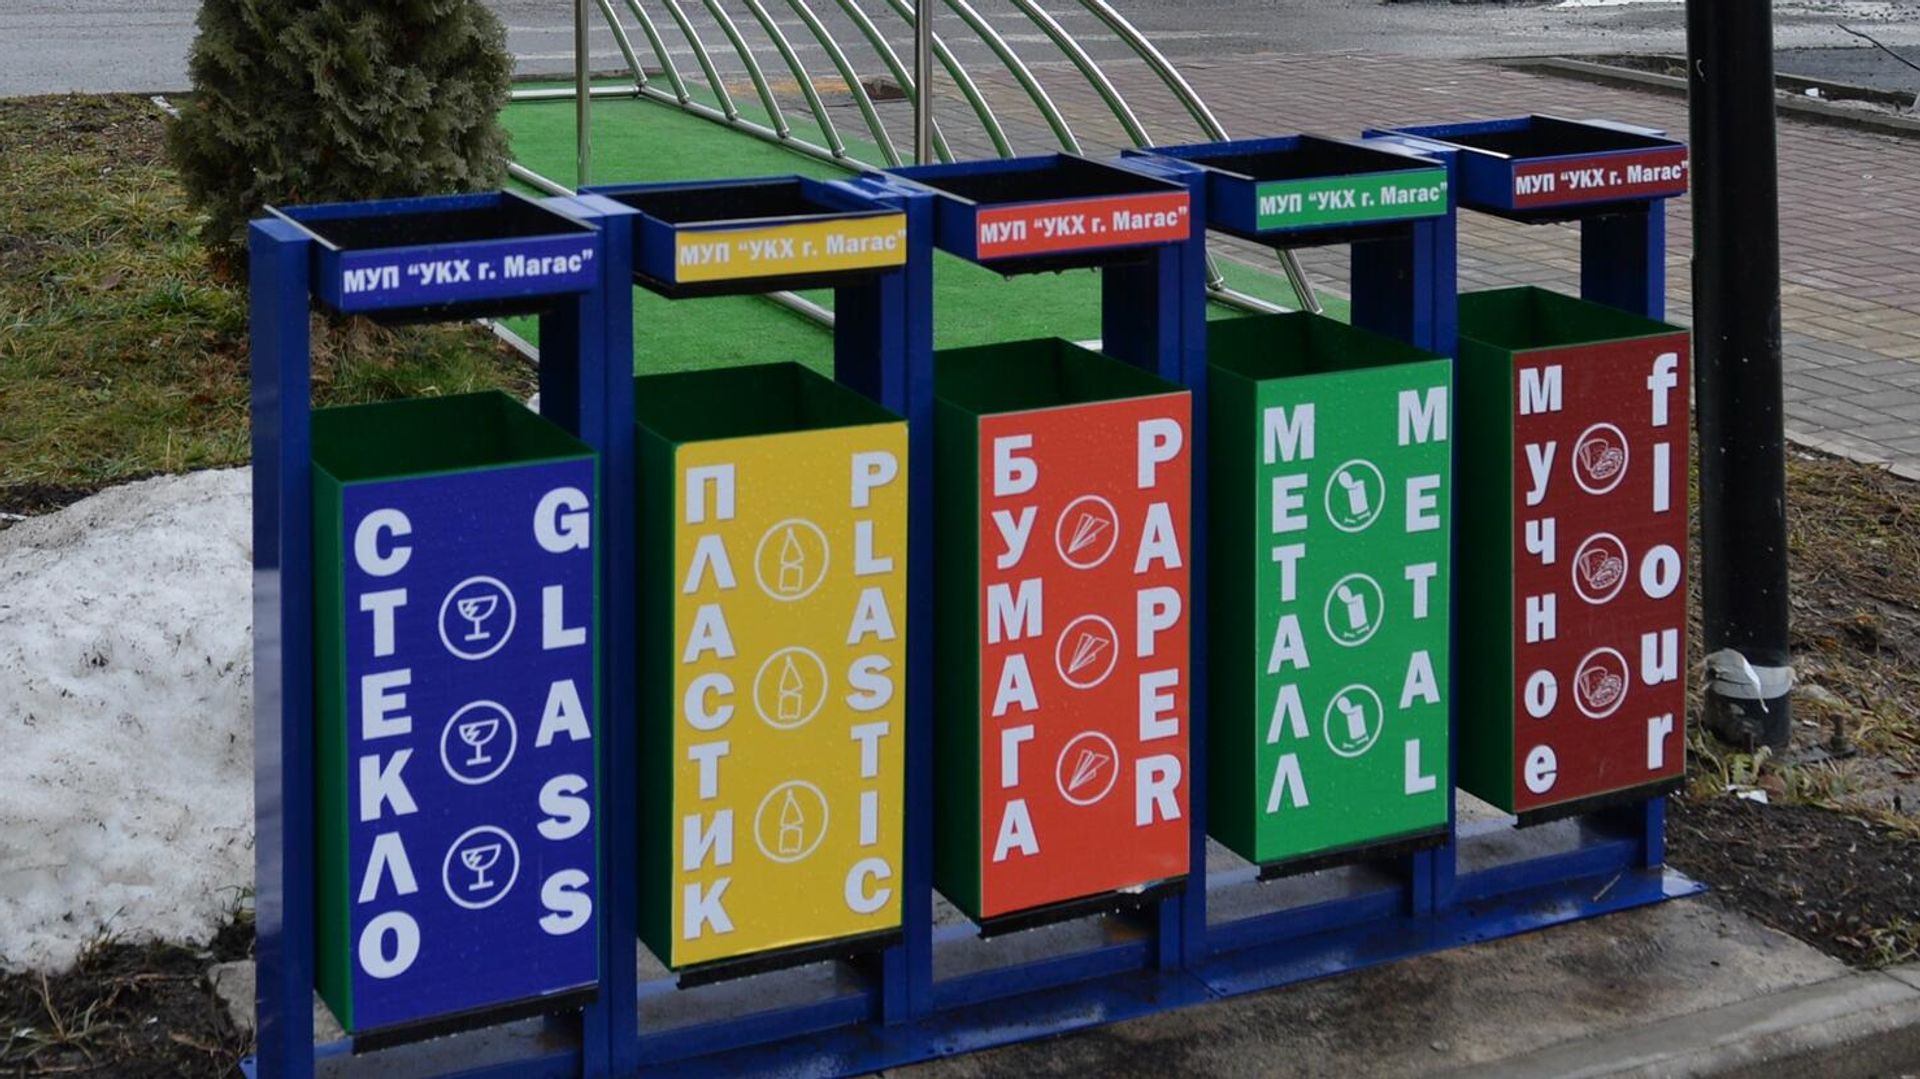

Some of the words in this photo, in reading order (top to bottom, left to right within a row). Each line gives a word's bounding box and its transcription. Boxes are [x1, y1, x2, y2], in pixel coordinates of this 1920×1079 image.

[344, 266, 399, 293] МУП
[478, 262, 496, 280] г.
[680, 243, 729, 266] МУП
[803, 241, 817, 257] г.
[980, 221, 1026, 244] МУП
[1091, 218, 1106, 233] г.
[1260, 193, 1302, 216] МУП
[1362, 193, 1374, 207] г.
[1516, 173, 1554, 195] МУП
[1609, 171, 1622, 185] г.
[354, 508, 421, 980] СТЕКЛО
[533, 486, 593, 935] GLASS
[682, 463, 737, 940] ПЛАСТИК
[844, 451, 898, 914] PLASTIC
[987, 434, 1043, 863] БУМАГА
[1134, 417, 1183, 826] PAPER
[1263, 403, 1315, 814] МЕТАЛЛ
[1398, 386, 1449, 796] METAL
[1640, 352, 1681, 770] flour
